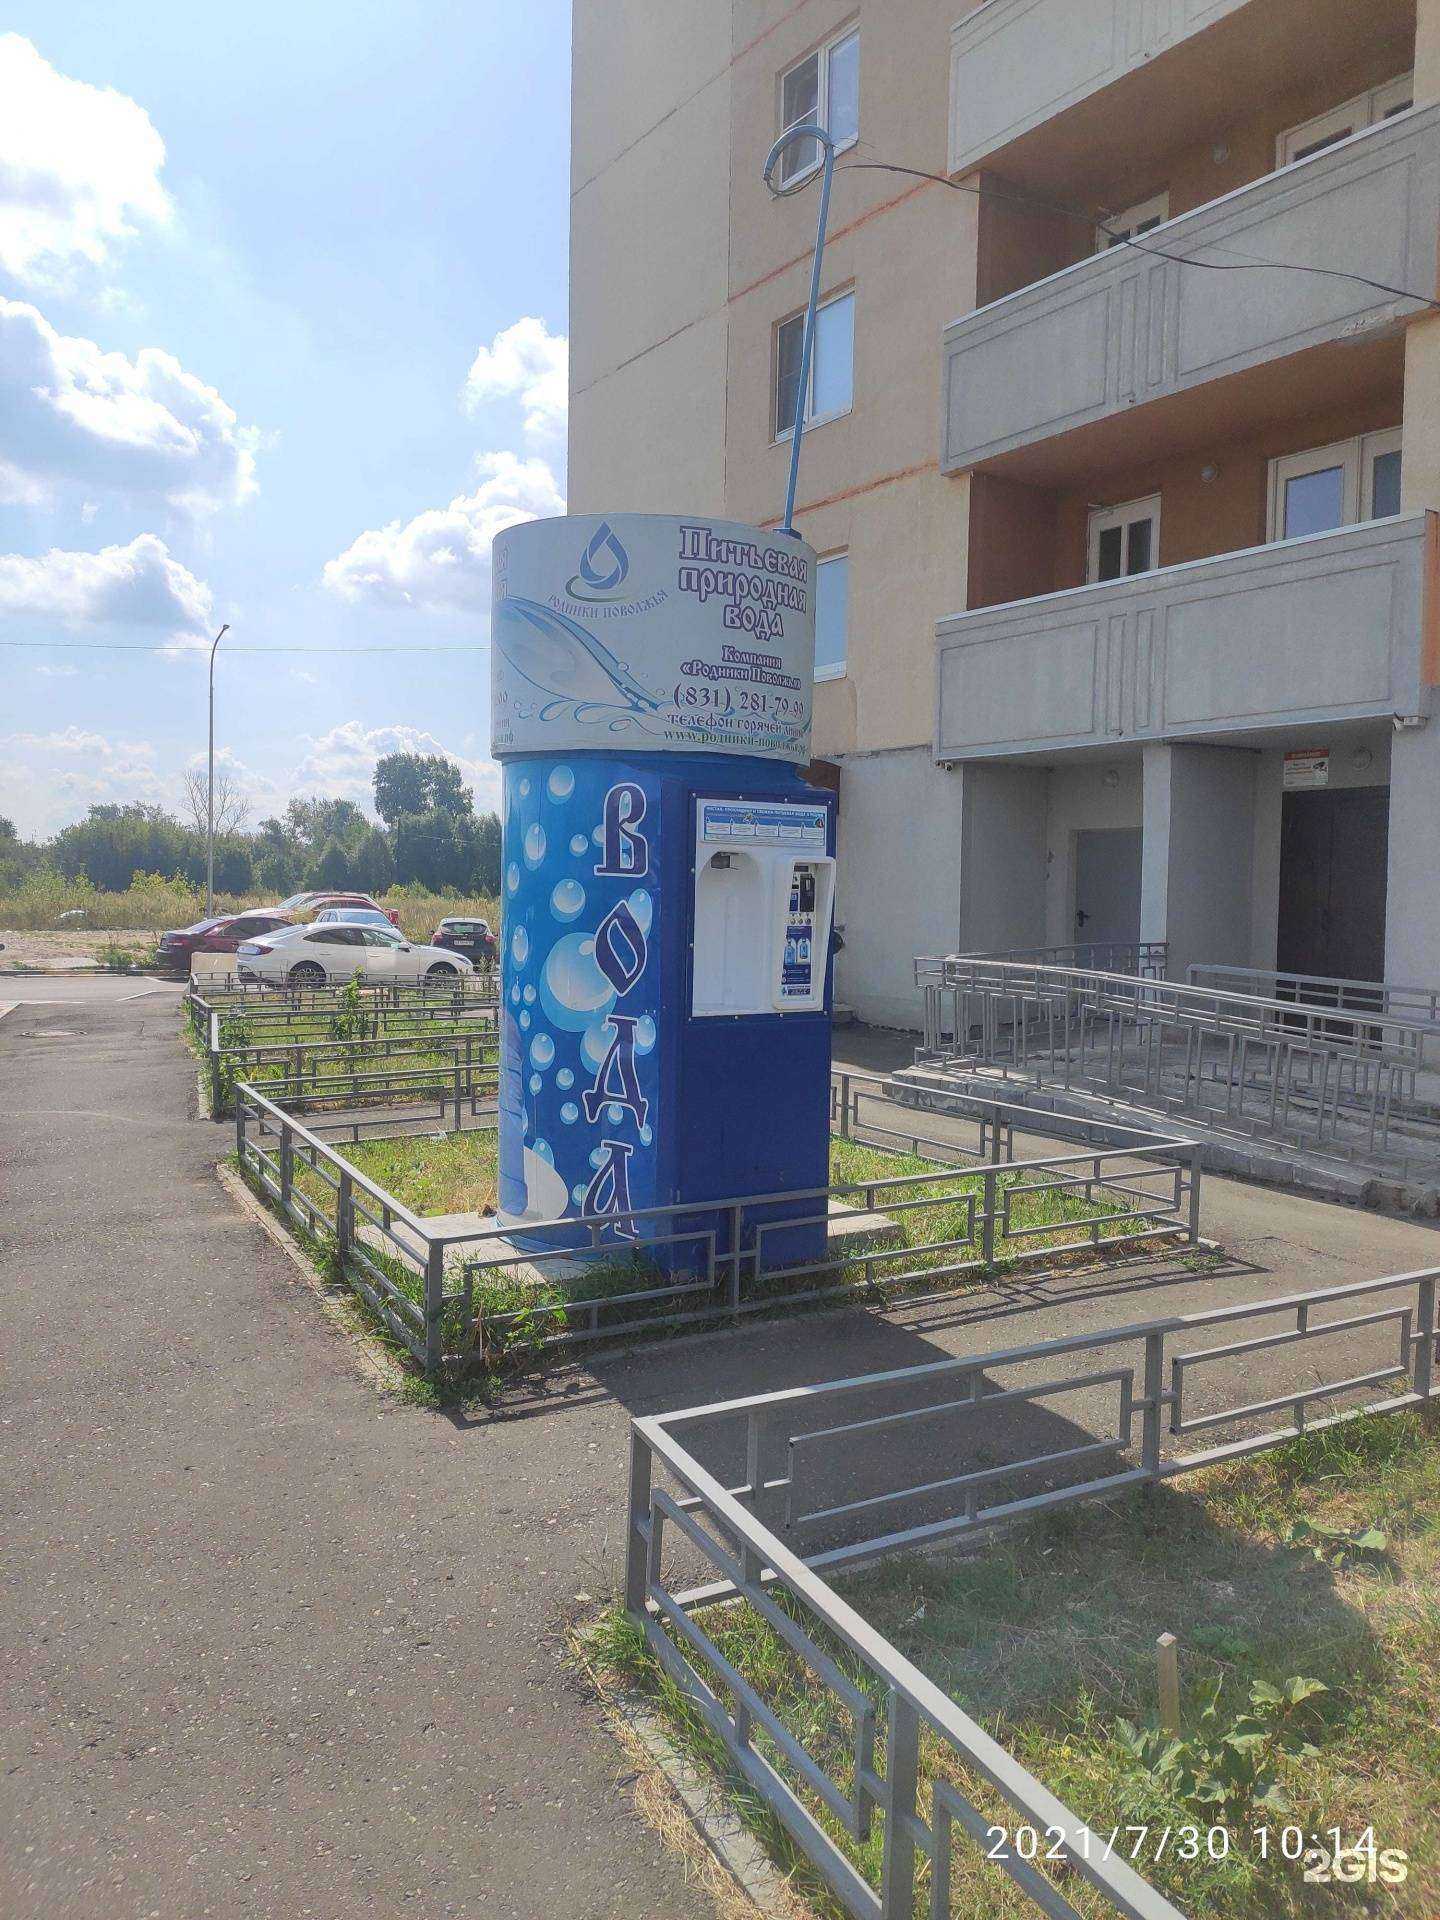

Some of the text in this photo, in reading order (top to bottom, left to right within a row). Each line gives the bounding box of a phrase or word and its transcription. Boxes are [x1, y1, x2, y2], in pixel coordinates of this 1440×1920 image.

[679, 525, 808, 583] Питьевая
[679, 566, 807, 613] природная
[723, 605, 785, 642] вода
[721, 645, 783, 670] Компания
[673, 683, 732, 713] (831)
